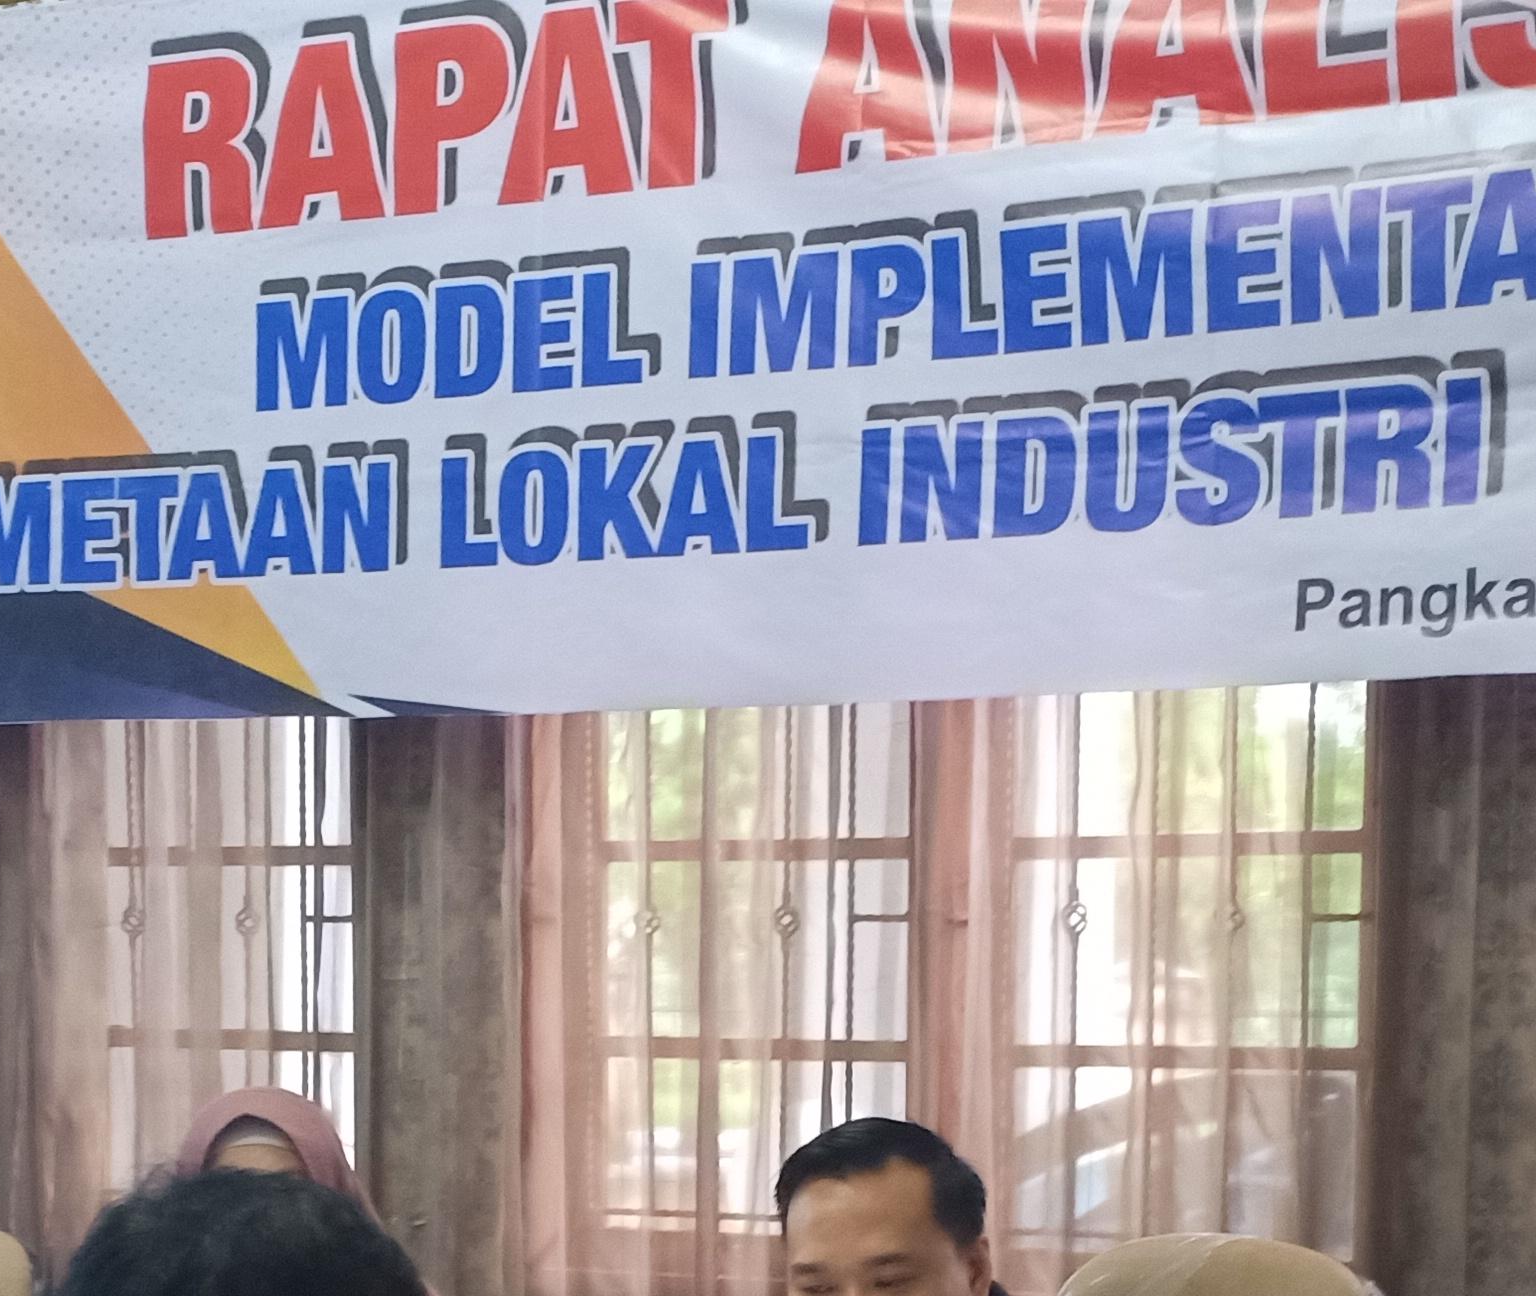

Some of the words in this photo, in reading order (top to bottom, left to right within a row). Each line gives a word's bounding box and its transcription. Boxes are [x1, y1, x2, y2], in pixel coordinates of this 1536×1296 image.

[144, 0, 728, 239] RAPAT
[255, 271, 643, 412] MODEL
[440, 435, 809, 569] LOKAL
[860, 362, 1482, 547] INDUSTRI
